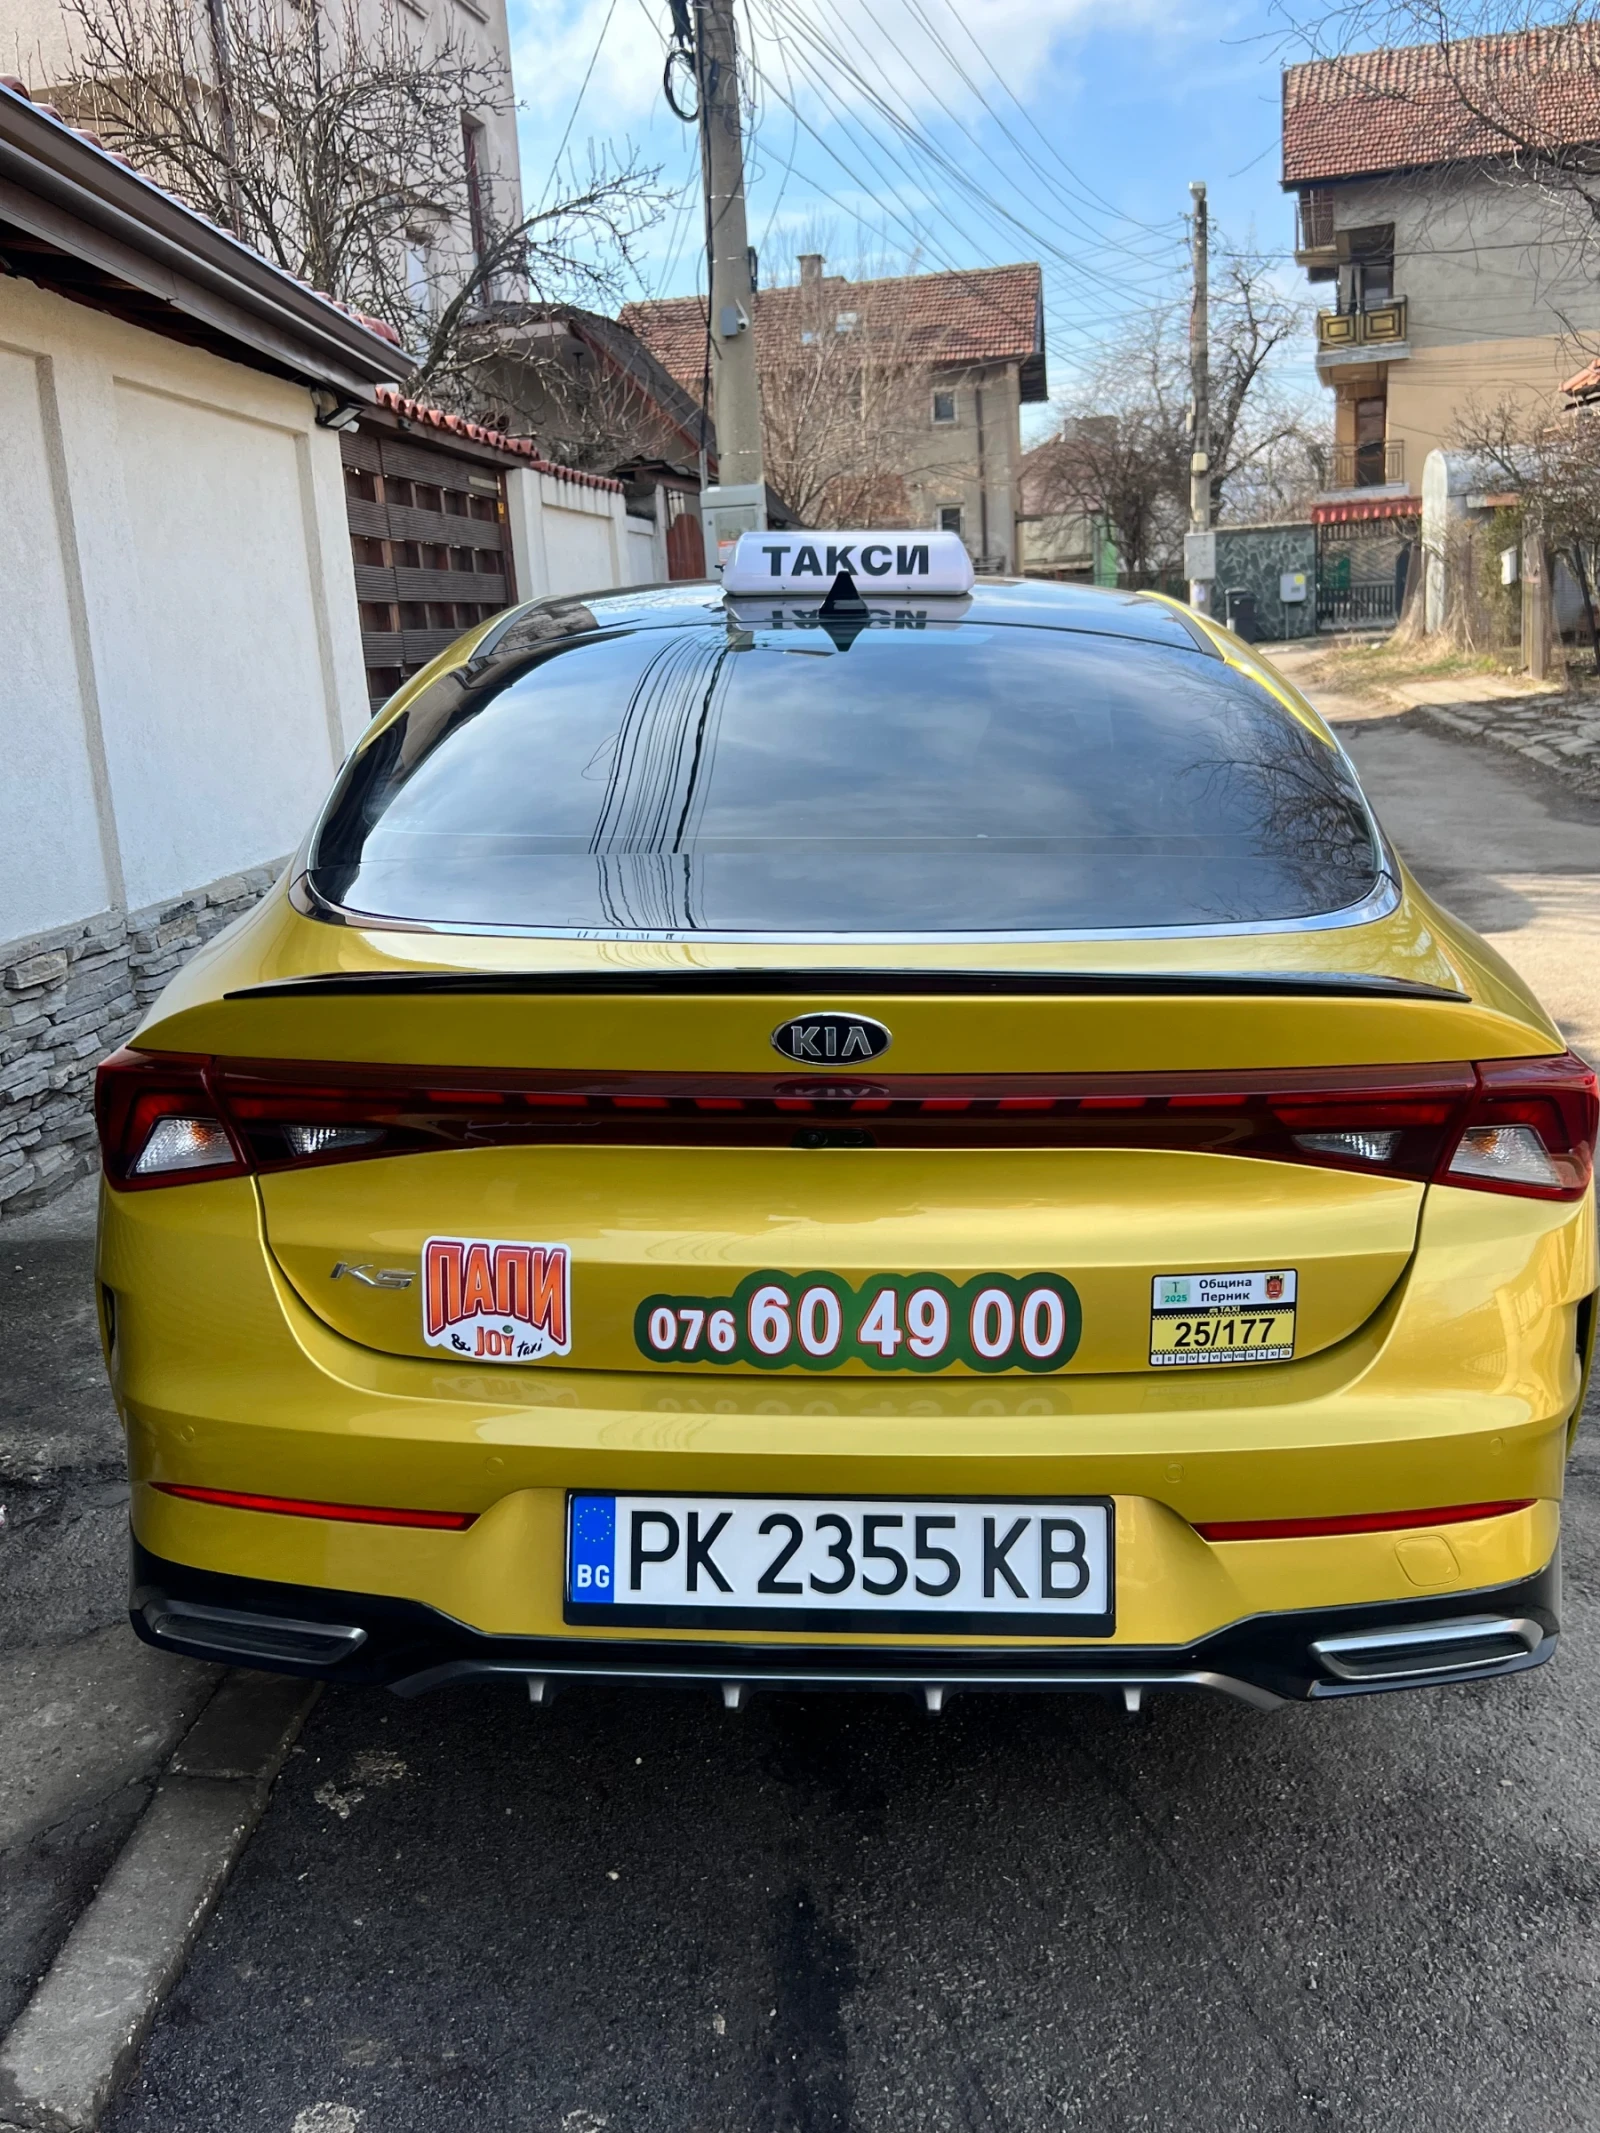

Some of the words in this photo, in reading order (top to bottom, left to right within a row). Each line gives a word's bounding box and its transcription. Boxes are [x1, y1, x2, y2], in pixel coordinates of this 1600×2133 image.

[762, 545, 929, 576] ТАКСИ
[790, 1026, 873, 1056] KIA
[330, 1261, 417, 1289] K5
[1199, 1279, 1252, 1290] Община
[425, 1240, 567, 1346] ПАПИ
[1164, 1294, 1187, 1303] 2025
[1201, 1292, 1250, 1304] Перник
[648, 1307, 736, 1352] 076
[747, 1284, 843, 1356] 60
[857, 1287, 950, 1357] 49
[969, 1287, 1066, 1358] 00
[1220, 1305, 1240, 1313] TAXI
[474, 1326, 515, 1356] JOY
[516, 1338, 543, 1357] taxi
[1174, 1318, 1275, 1347] 25/177
[629, 1510, 735, 1593] PK
[757, 1513, 961, 1596] 2355
[982, 1517, 1091, 1599] KB
[577, 1564, 610, 1589] BG
